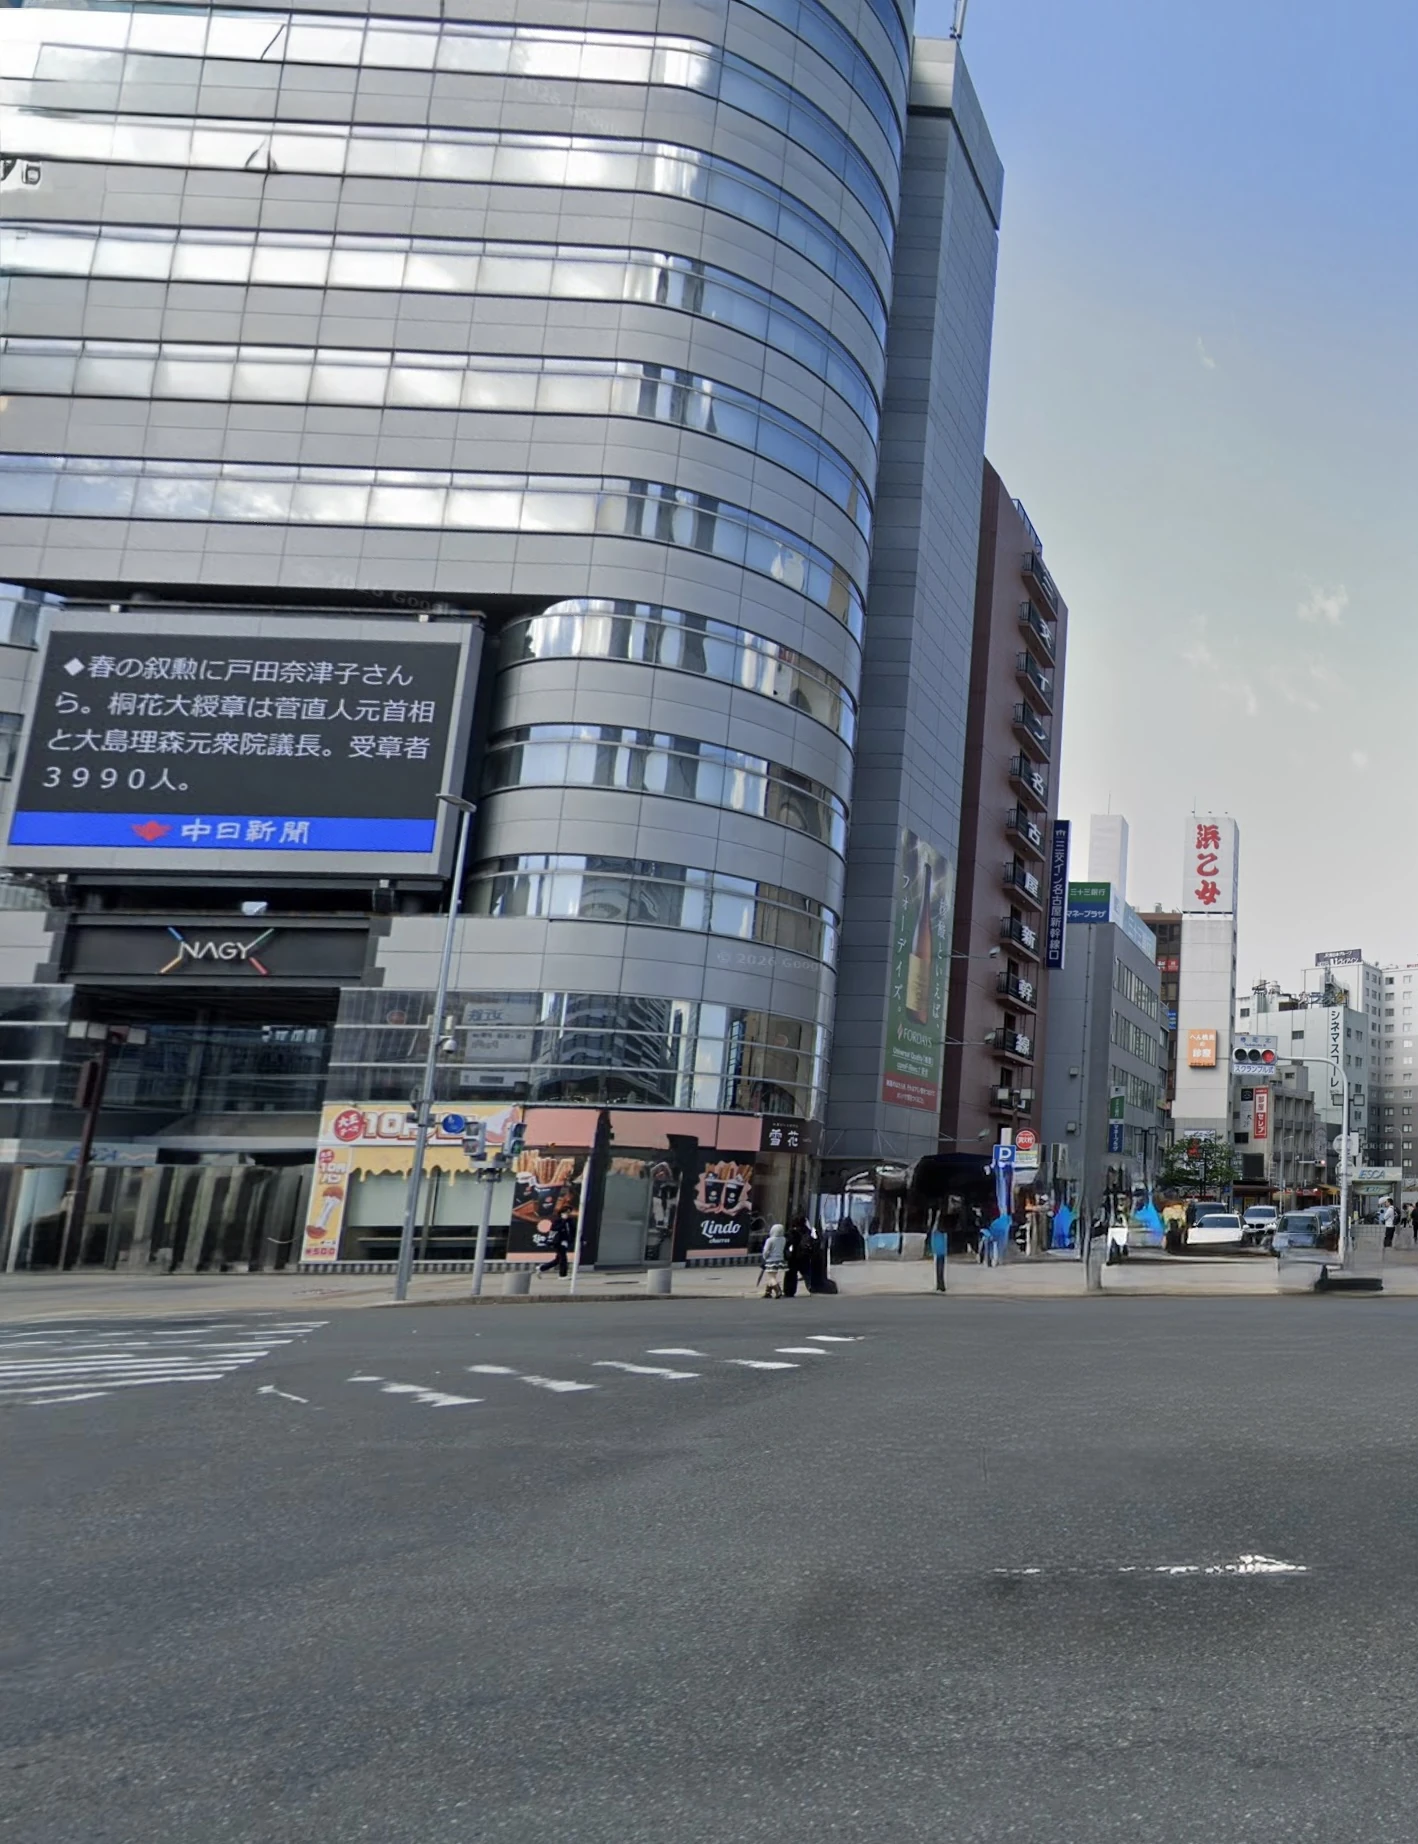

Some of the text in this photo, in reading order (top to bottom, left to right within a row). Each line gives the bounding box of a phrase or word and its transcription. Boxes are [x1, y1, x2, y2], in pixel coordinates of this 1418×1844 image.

[88, 654, 413, 687] 春の叙勲に戸田奈津子さん
[180, 817, 311, 845] 中日新聞
[1195, 823, 1221, 906] 浜乙女
[1049, 840, 1067, 961] 三交イン名古屋新幹線口
[1070, 888, 1107, 897] 三十三銀行
[1066, 909, 1107, 919] マネープラザ
[903, 1027, 932, 1049] FORDAYS
[1330, 1010, 1340, 1088] シネマスコーレ
[1235, 1065, 1274, 1074] スクランブル式
[769, 1128, 800, 1148] 雪花
[1000, 1147, 1012, 1160] P
[1358, 1169, 1386, 1179] ESCA
[701, 1219, 741, 1237] Lindo
